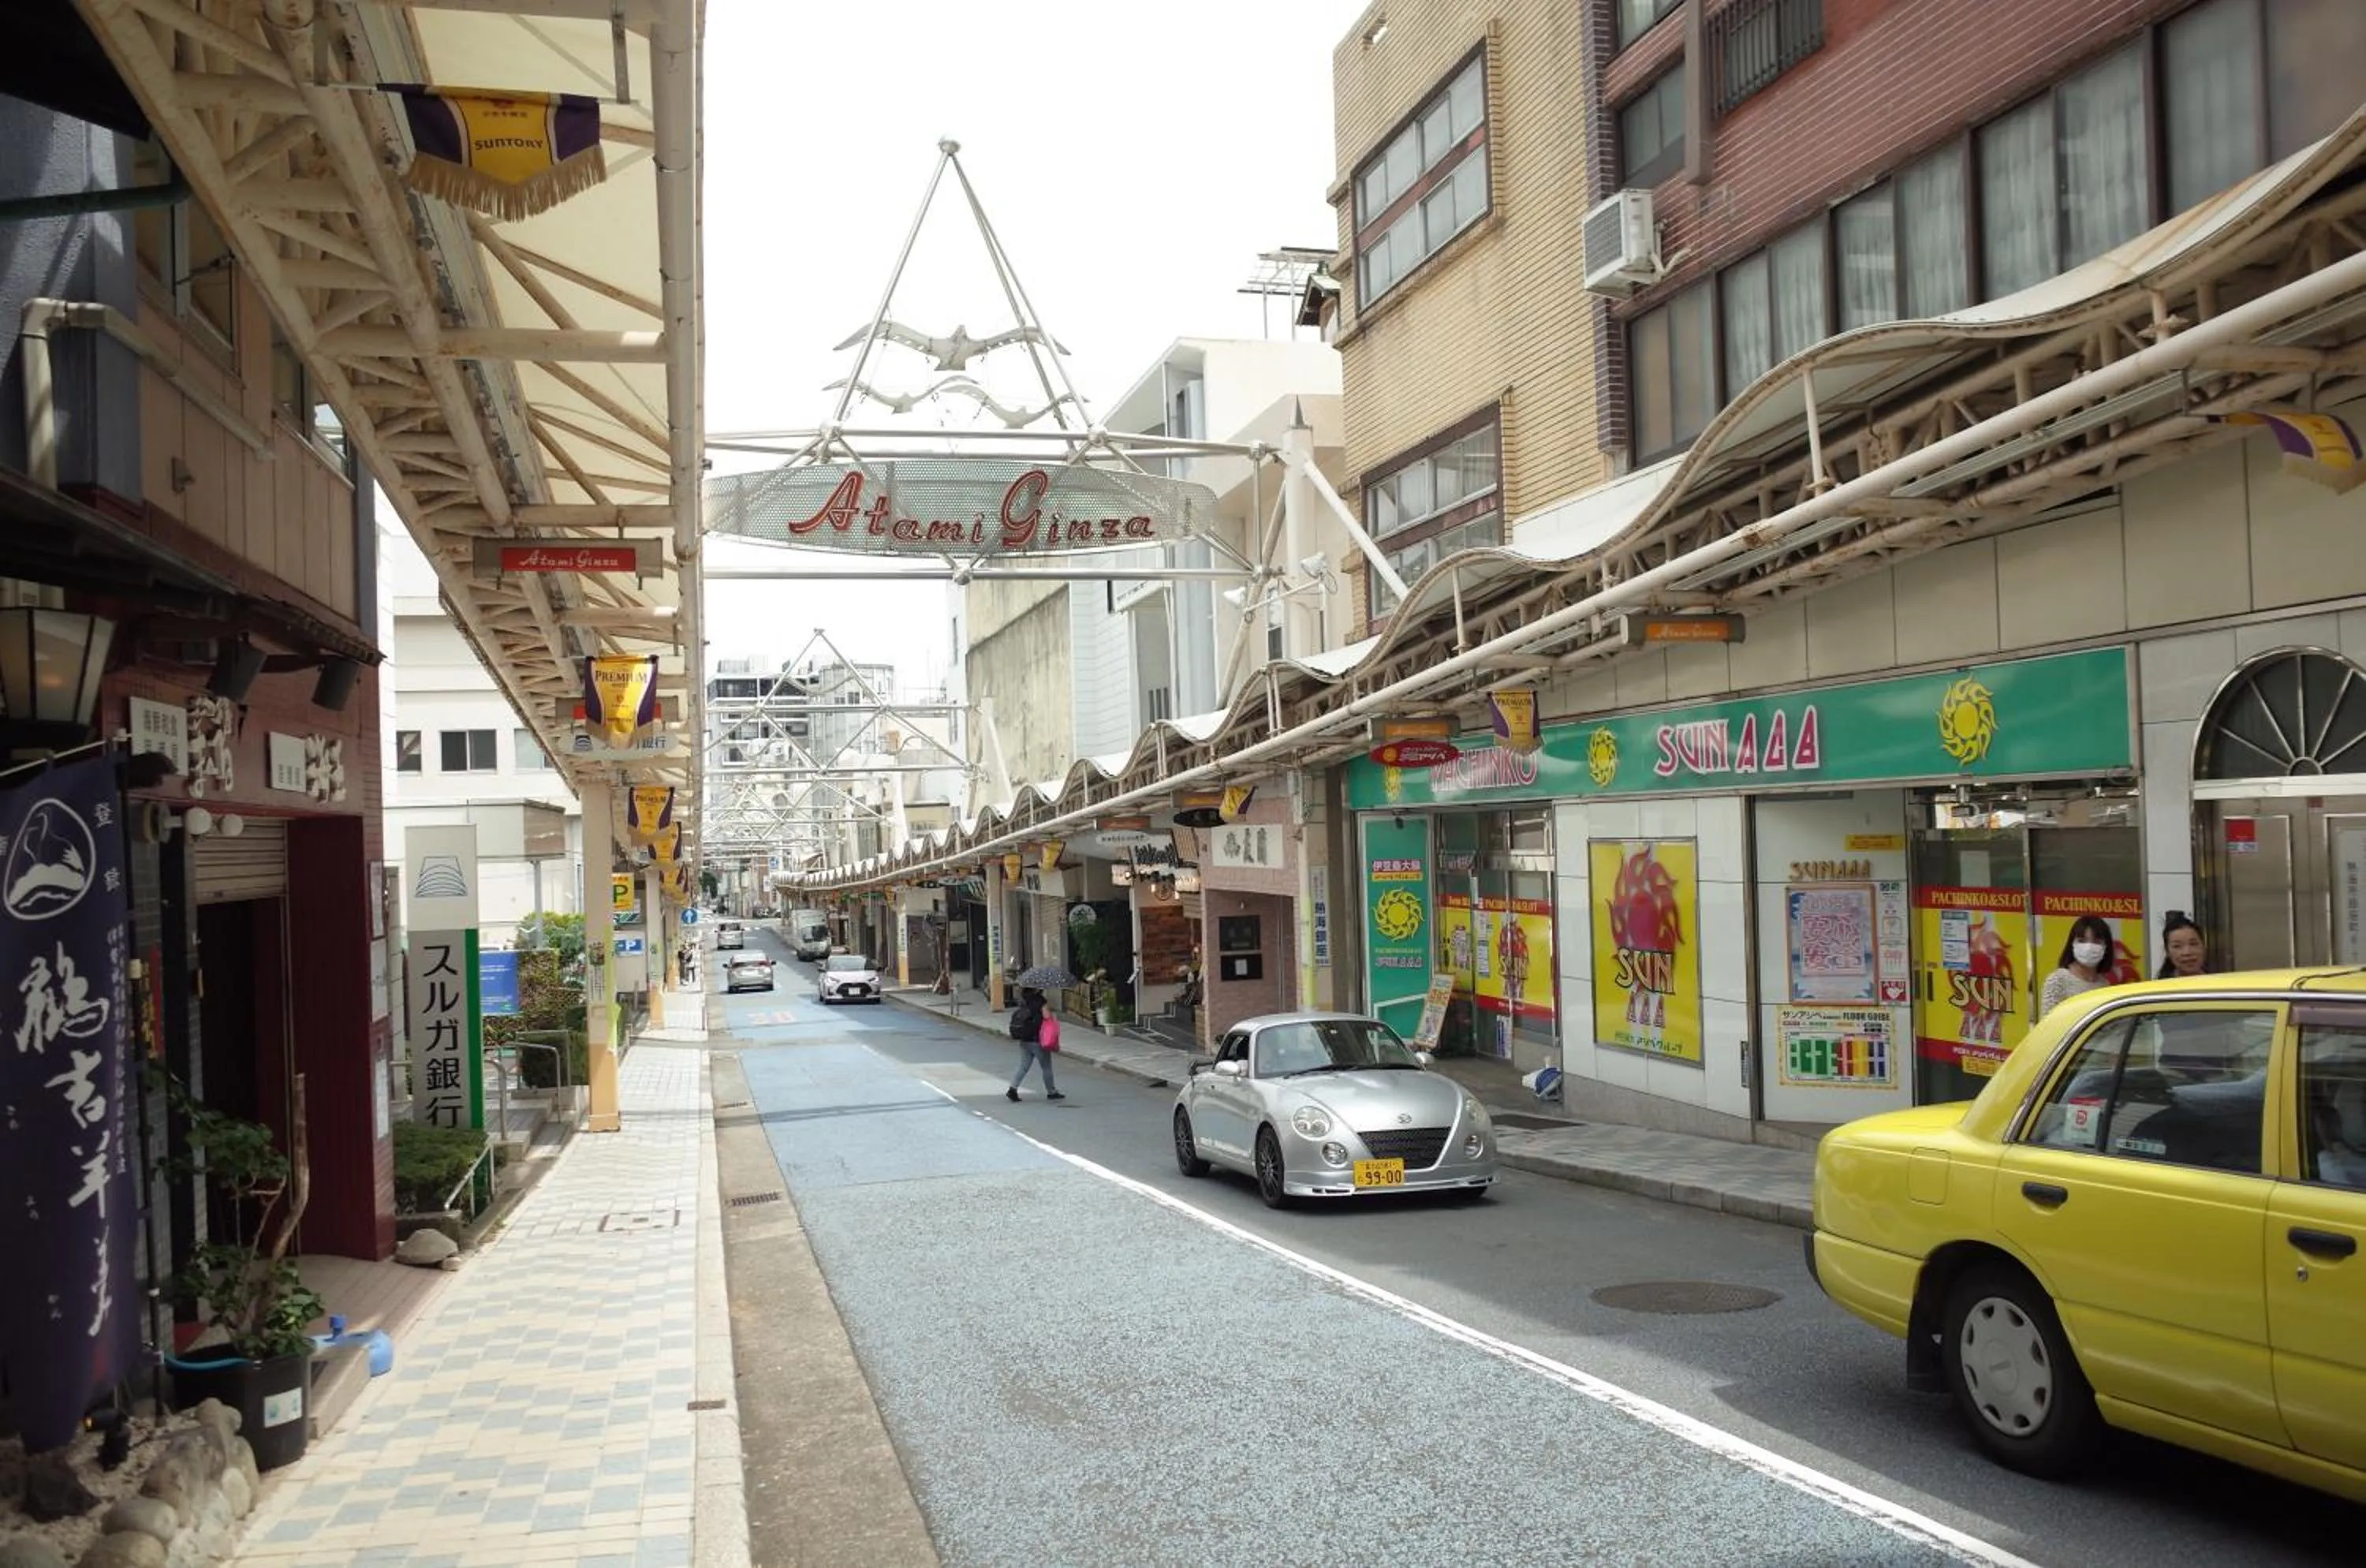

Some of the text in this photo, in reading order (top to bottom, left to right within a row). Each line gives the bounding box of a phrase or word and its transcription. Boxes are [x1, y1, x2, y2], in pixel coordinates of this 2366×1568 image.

[474, 137, 544, 151] SUNTORY
[789, 469, 1155, 547] Atami Ginza
[520, 550, 619, 568] Atami Ginza
[613, 884, 629, 903] P
[1614, 946, 1676, 995] SUN
[1949, 973, 2014, 1014] SUN
[423, 945, 465, 1129] スルガ銀行
[1365, 1170, 1401, 1185] 99-00
